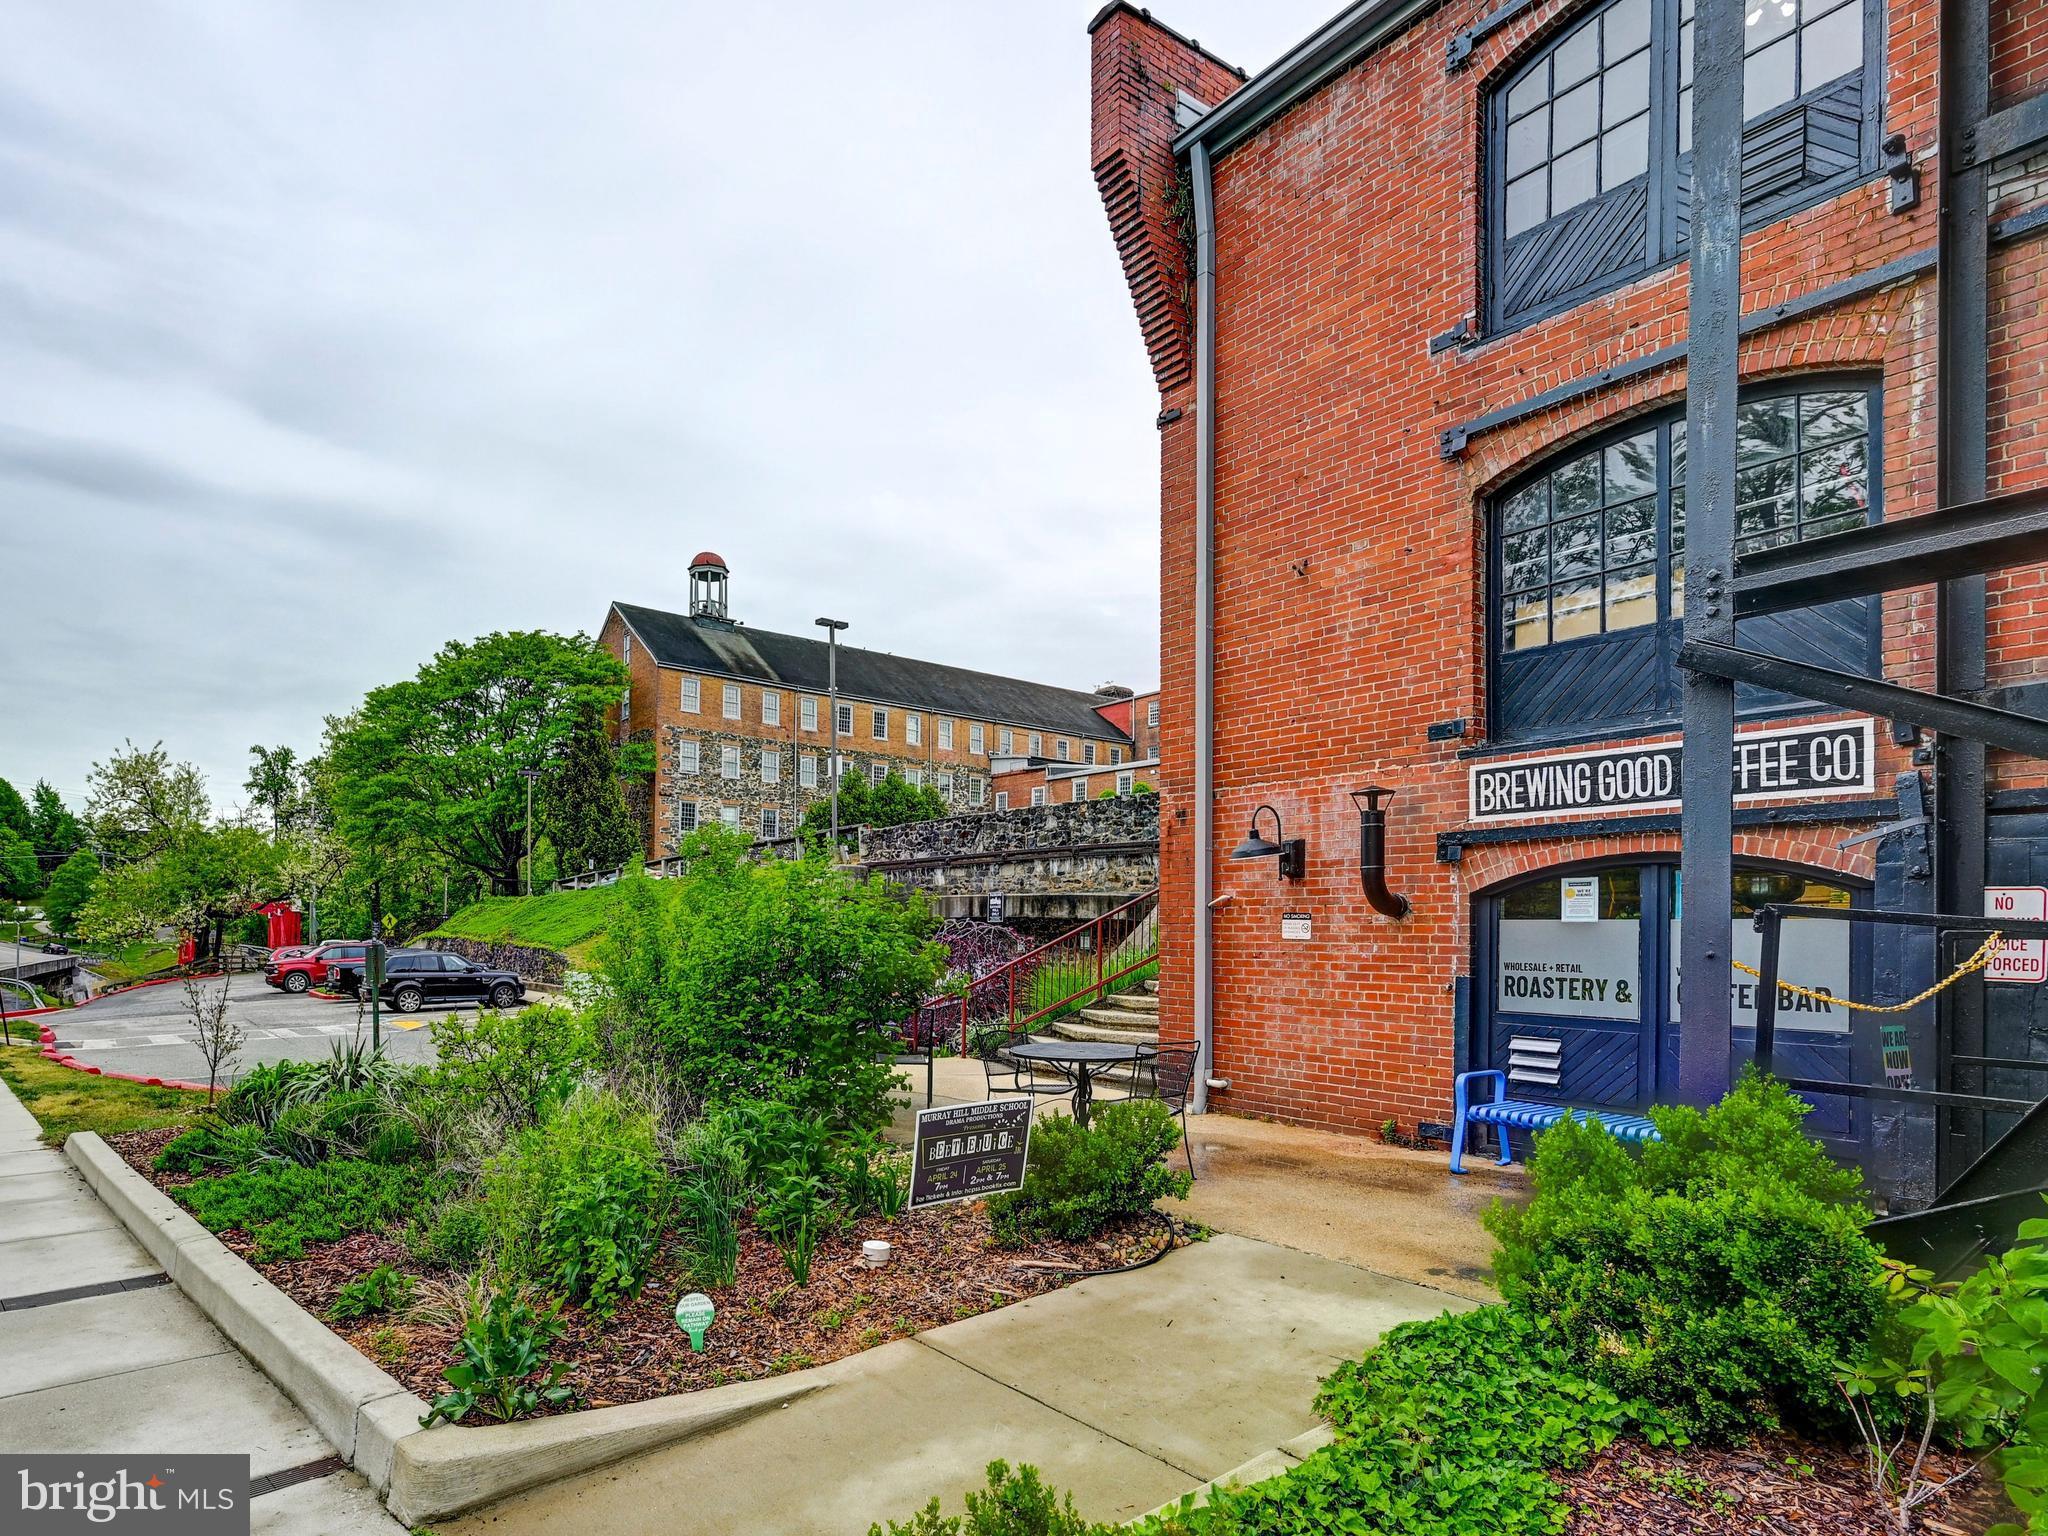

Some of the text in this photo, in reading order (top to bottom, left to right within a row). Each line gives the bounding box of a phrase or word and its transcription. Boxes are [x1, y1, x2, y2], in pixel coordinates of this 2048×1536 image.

[1480, 761, 1591, 812] BREWING
[1598, 754, 1673, 802] GOOD
[1809, 733, 1860, 782] CO.
[1995, 896, 2014, 911] NO
[1987, 939, 2028, 951] OLICE
[1503, 962, 1548, 972] WHOLESALE
[1555, 963, 1583, 974] RETAIL
[1984, 957, 2039, 972] FORCED
[1504, 975, 1633, 1003] ROASTERY &
[1777, 984, 1833, 1014] BAR
[1882, 1031, 1894, 1048] WE
[1885, 1049, 1909, 1070] NOW
[921, 1102, 1029, 1123] MURRAY HILL MIDDLE SCHOOL
[945, 1113, 1004, 1126] DRAMA PRODUCTIONS
[976, 1163, 1007, 1174] APRIL 25
[927, 1172, 948, 1183] APRIL
